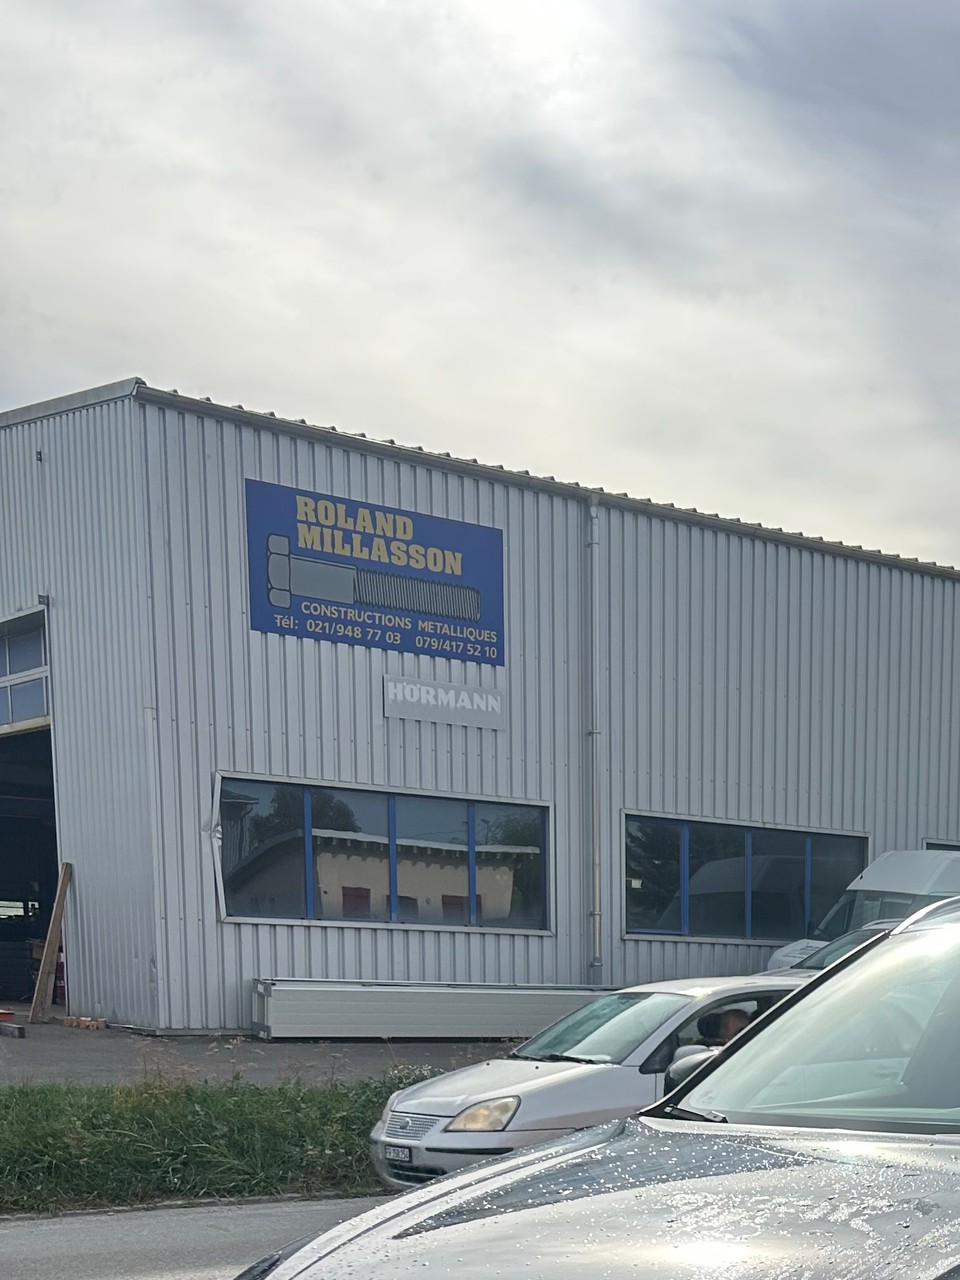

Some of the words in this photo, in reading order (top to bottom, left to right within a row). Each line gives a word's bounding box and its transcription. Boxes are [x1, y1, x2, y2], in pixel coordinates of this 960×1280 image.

[296, 495, 414, 540] ROLAND
[297, 523, 463, 576] MILLASSON
[301, 601, 412, 629] CONSTRUCTIONS
[418, 620, 498, 643] METALLIQUES
[306, 619, 362, 639] 021/948
[366, 628, 382, 641] 77
[385, 631, 401, 645] 03
[415, 635, 464, 654] 079/417
[466, 643, 482, 657] 52
[484, 646, 498, 659] 10
[387, 681, 501, 714] HÖRMANN
